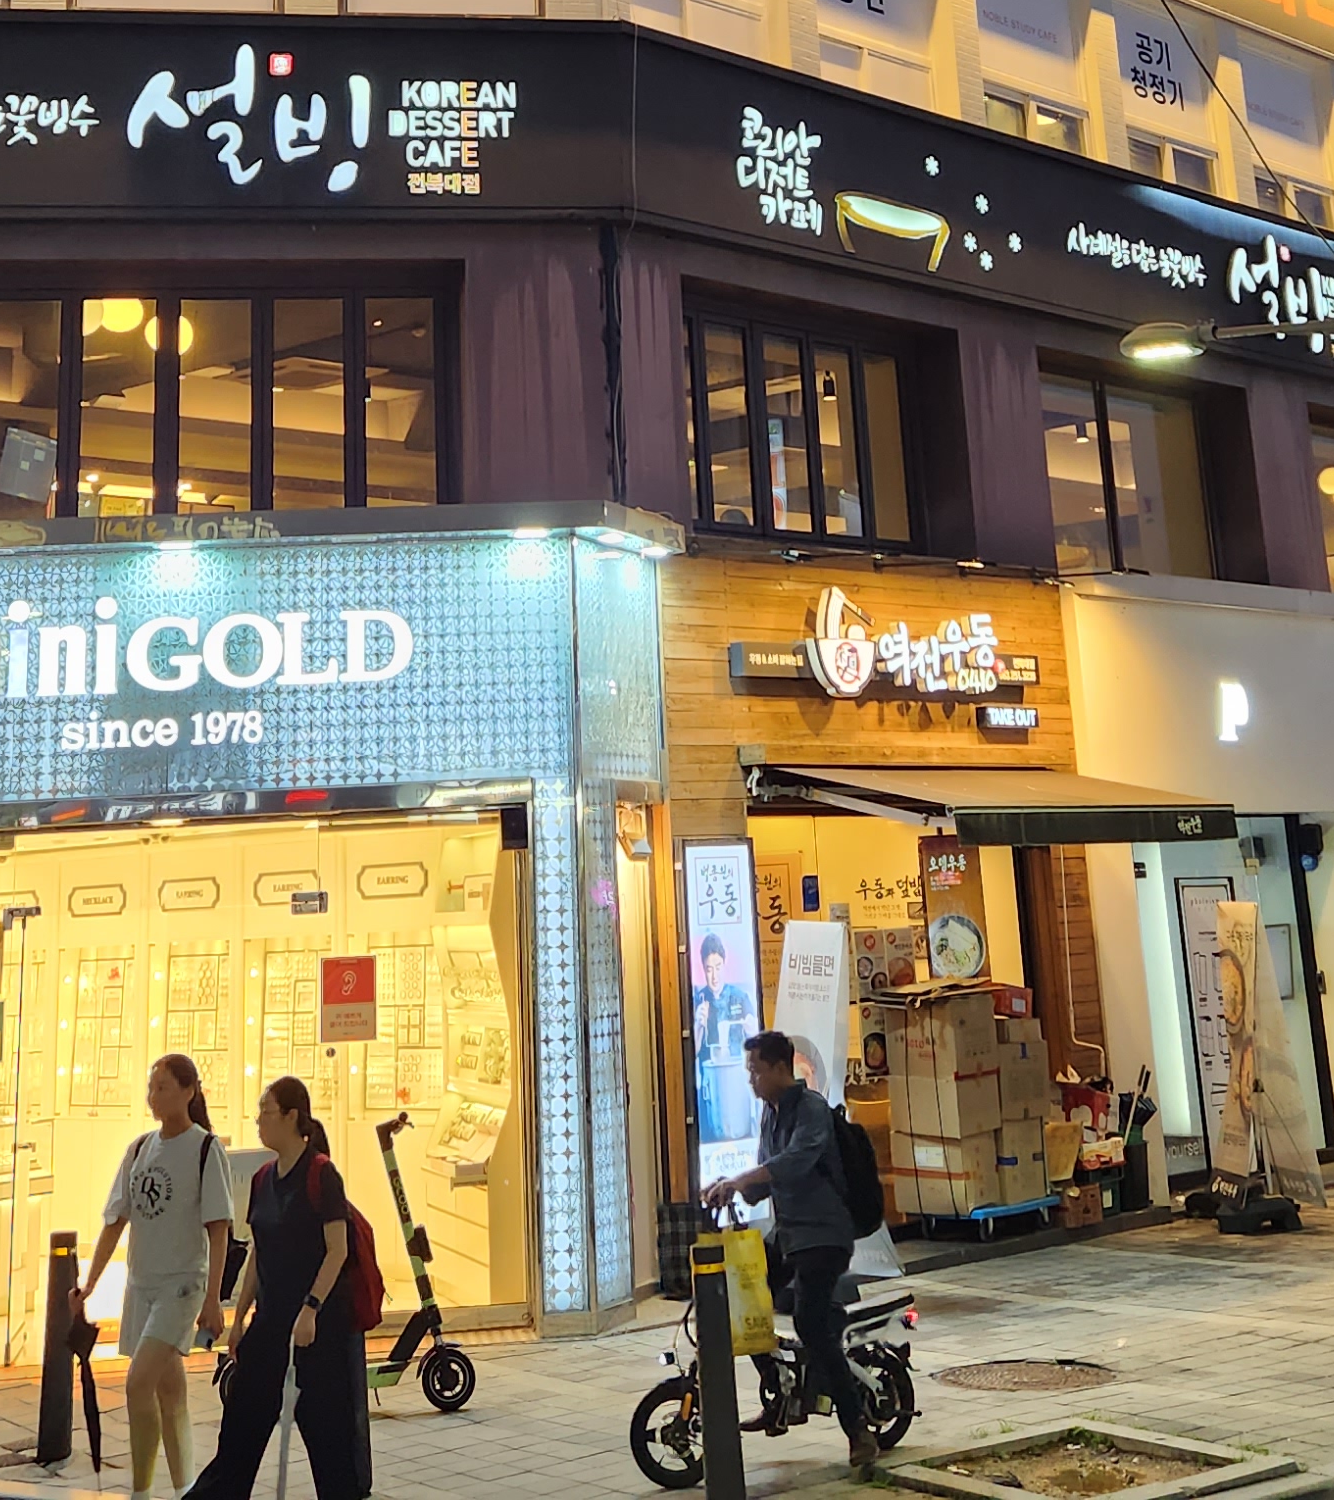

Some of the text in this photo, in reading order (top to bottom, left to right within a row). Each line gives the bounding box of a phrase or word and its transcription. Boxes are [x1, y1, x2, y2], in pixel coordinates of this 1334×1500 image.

[982, 8, 1058, 43] NOBLE STUDY CAFE
[1136, 31, 1171, 71] 공기
[401, 81, 516, 108] KOREAN
[1130, 65, 1185, 111] 청정기
[127, 43, 371, 192] 설빙
[388, 111, 514, 140] DESSERT
[740, 105, 821, 164] 코리안
[405, 141, 479, 168] CAFE
[407, 172, 481, 195] 전북대점
[737, 155, 814, 198] 디저트
[760, 191, 822, 236] 카페
[878, 614, 998, 692] 역전우동
[957, 668, 998, 694] 0410
[989, 708, 1037, 726] TAKE OUT
[1219, 683, 1249, 741] P
[61, 711, 264, 750] since 1978
[273, 882, 303, 893] EARRING
[376, 875, 408, 886] EARRING
[82, 896, 114, 905] NECKLACE
[699, 884, 738, 920] 우동
